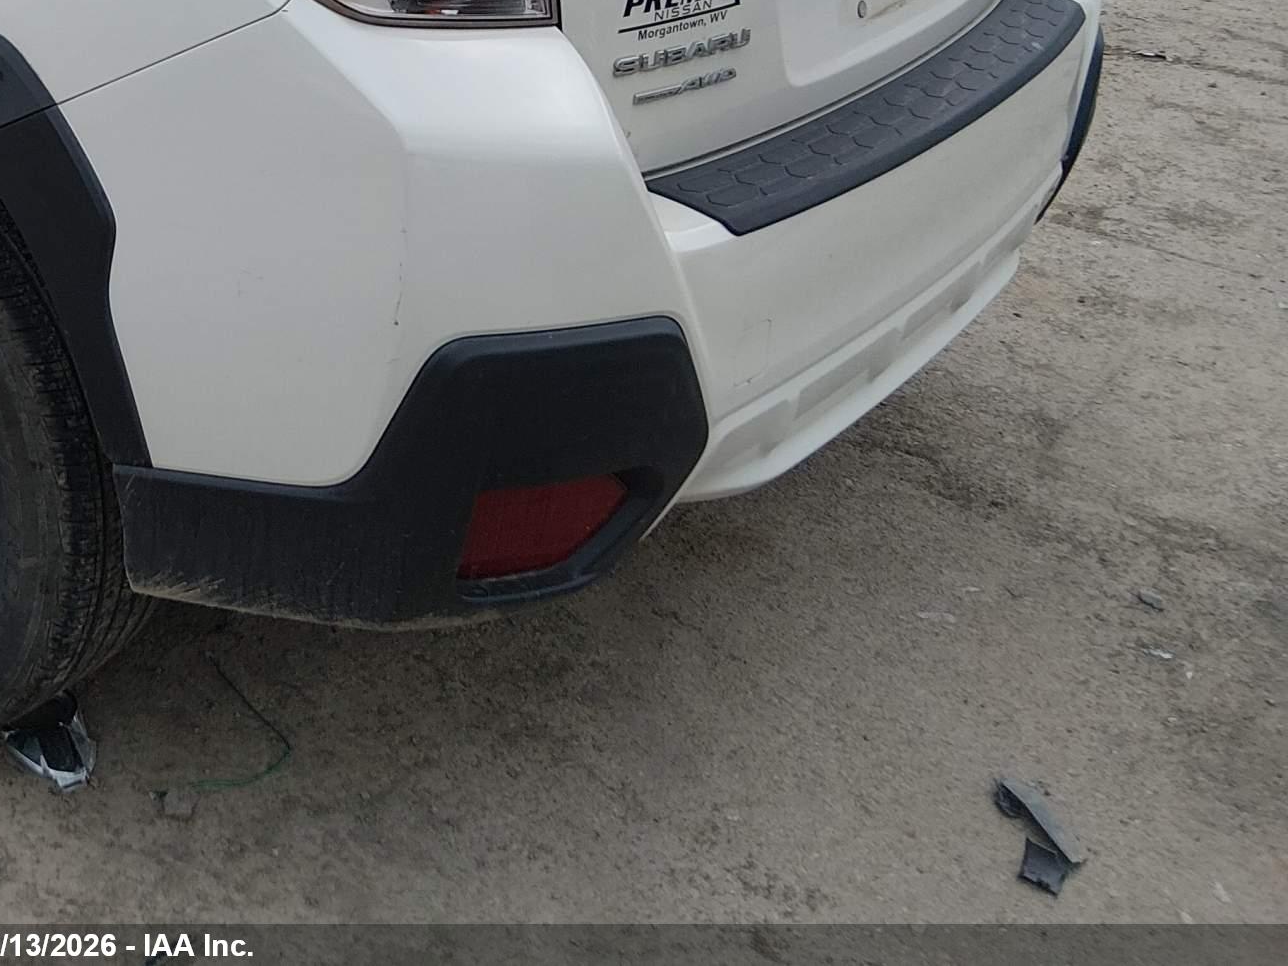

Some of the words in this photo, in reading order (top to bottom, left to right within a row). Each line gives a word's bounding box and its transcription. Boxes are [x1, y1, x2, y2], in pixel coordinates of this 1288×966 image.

[637, 17, 707, 41] Morgantown,
[709, 10, 729, 24] WV
[654, 0, 713, 21] NISSAN
[613, 28, 751, 78] SUBARU
